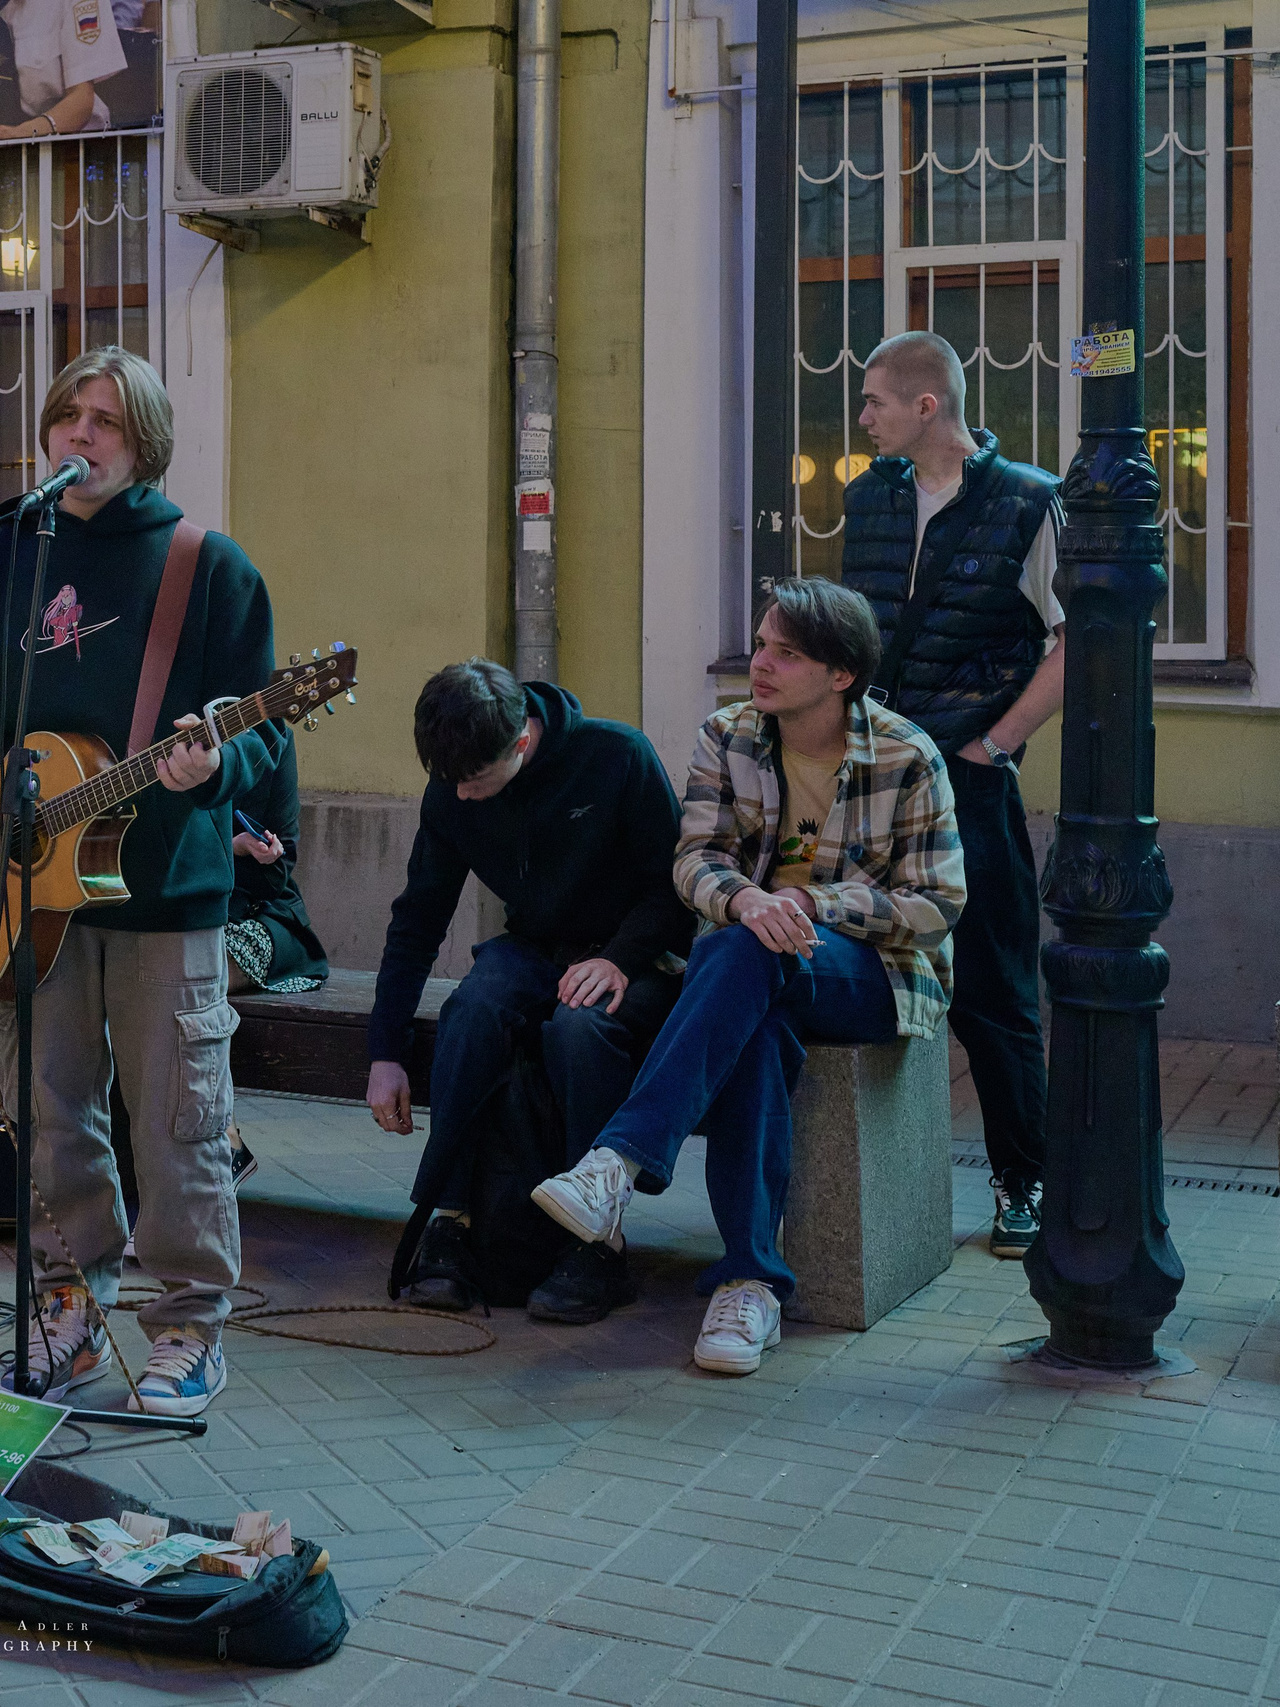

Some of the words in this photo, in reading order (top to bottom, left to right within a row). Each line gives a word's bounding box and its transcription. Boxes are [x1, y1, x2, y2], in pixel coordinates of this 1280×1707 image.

[300, 111, 338, 120] BALLU
[1074, 333, 1129, 347] РАБОТА
[295, 678, 317, 696] Cort
